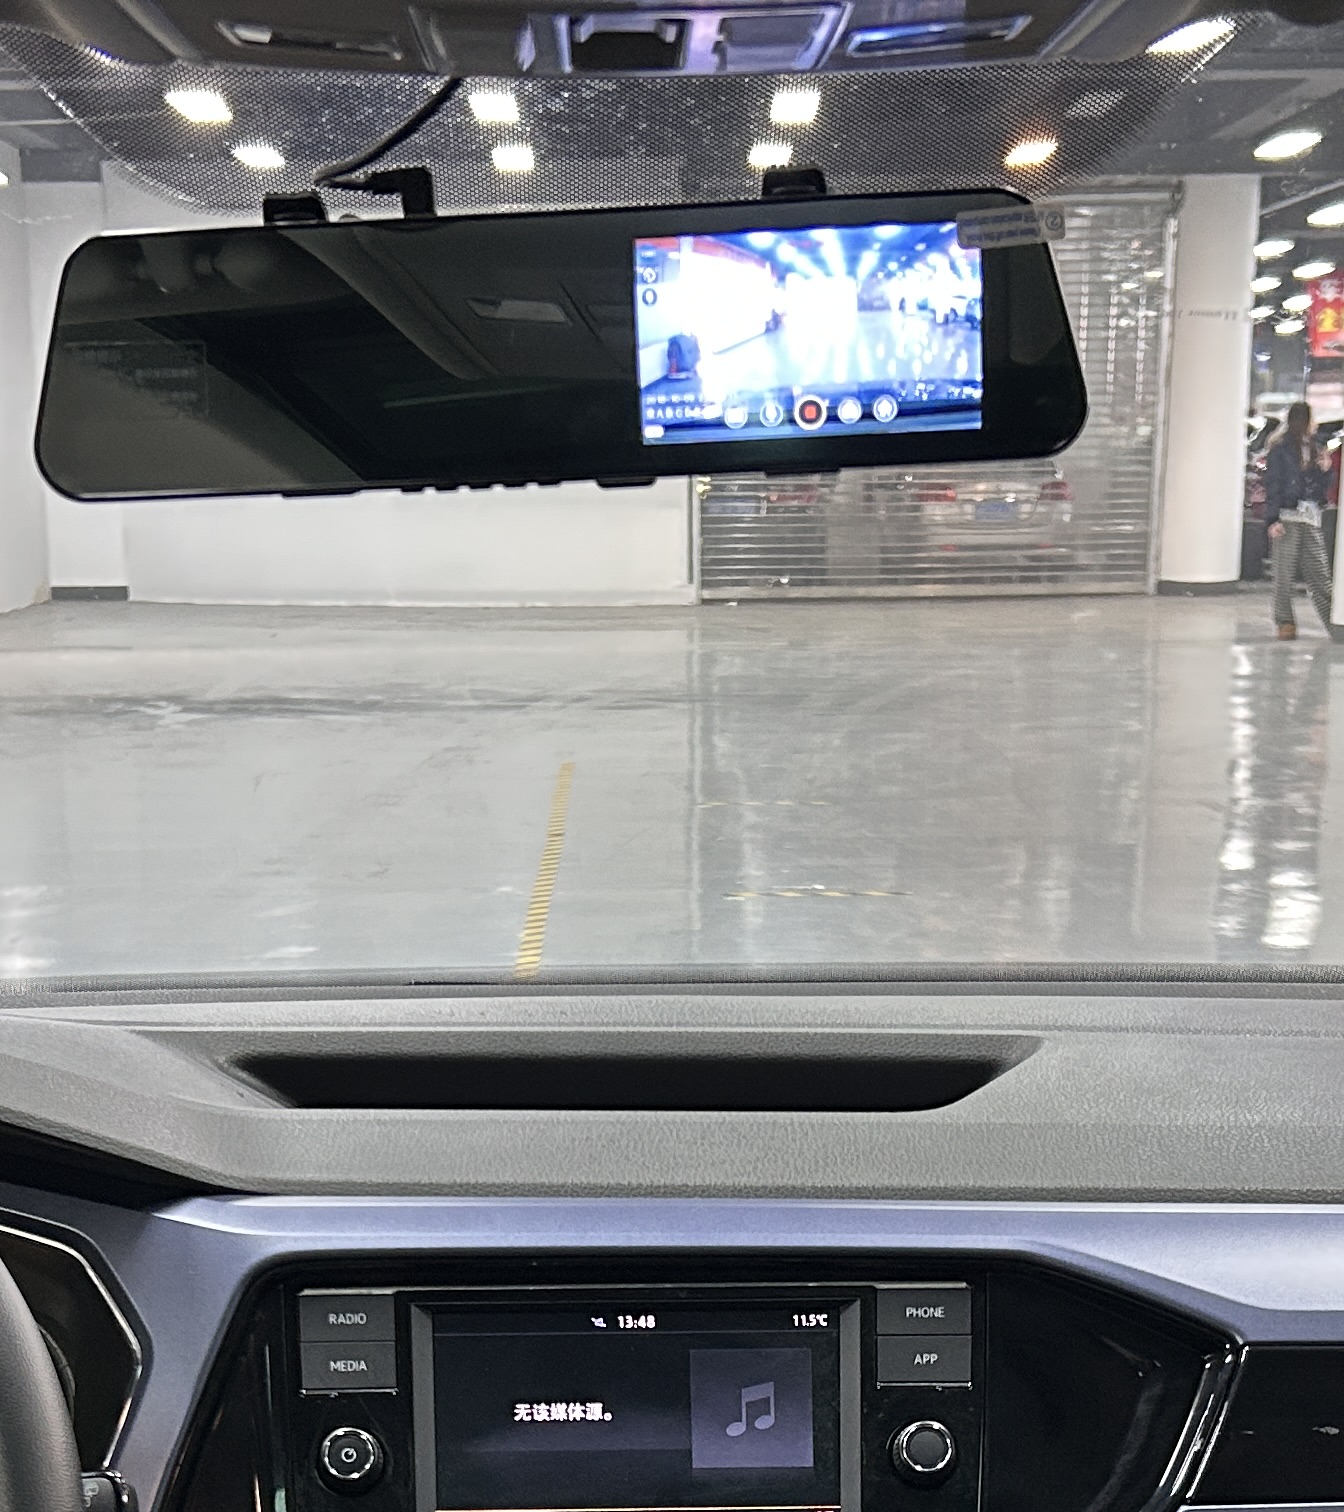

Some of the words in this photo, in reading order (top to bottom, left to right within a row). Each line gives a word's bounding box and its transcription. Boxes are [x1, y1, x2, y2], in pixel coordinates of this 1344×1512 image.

[906, 1306, 945, 1318] PHONE
[328, 1312, 367, 1325] RADIO
[617, 1315, 656, 1328] 13:48
[913, 1353, 938, 1365] APP
[329, 1360, 368, 1372] MEDIA
[513, 1402, 613, 1422] 无该媒体源。
